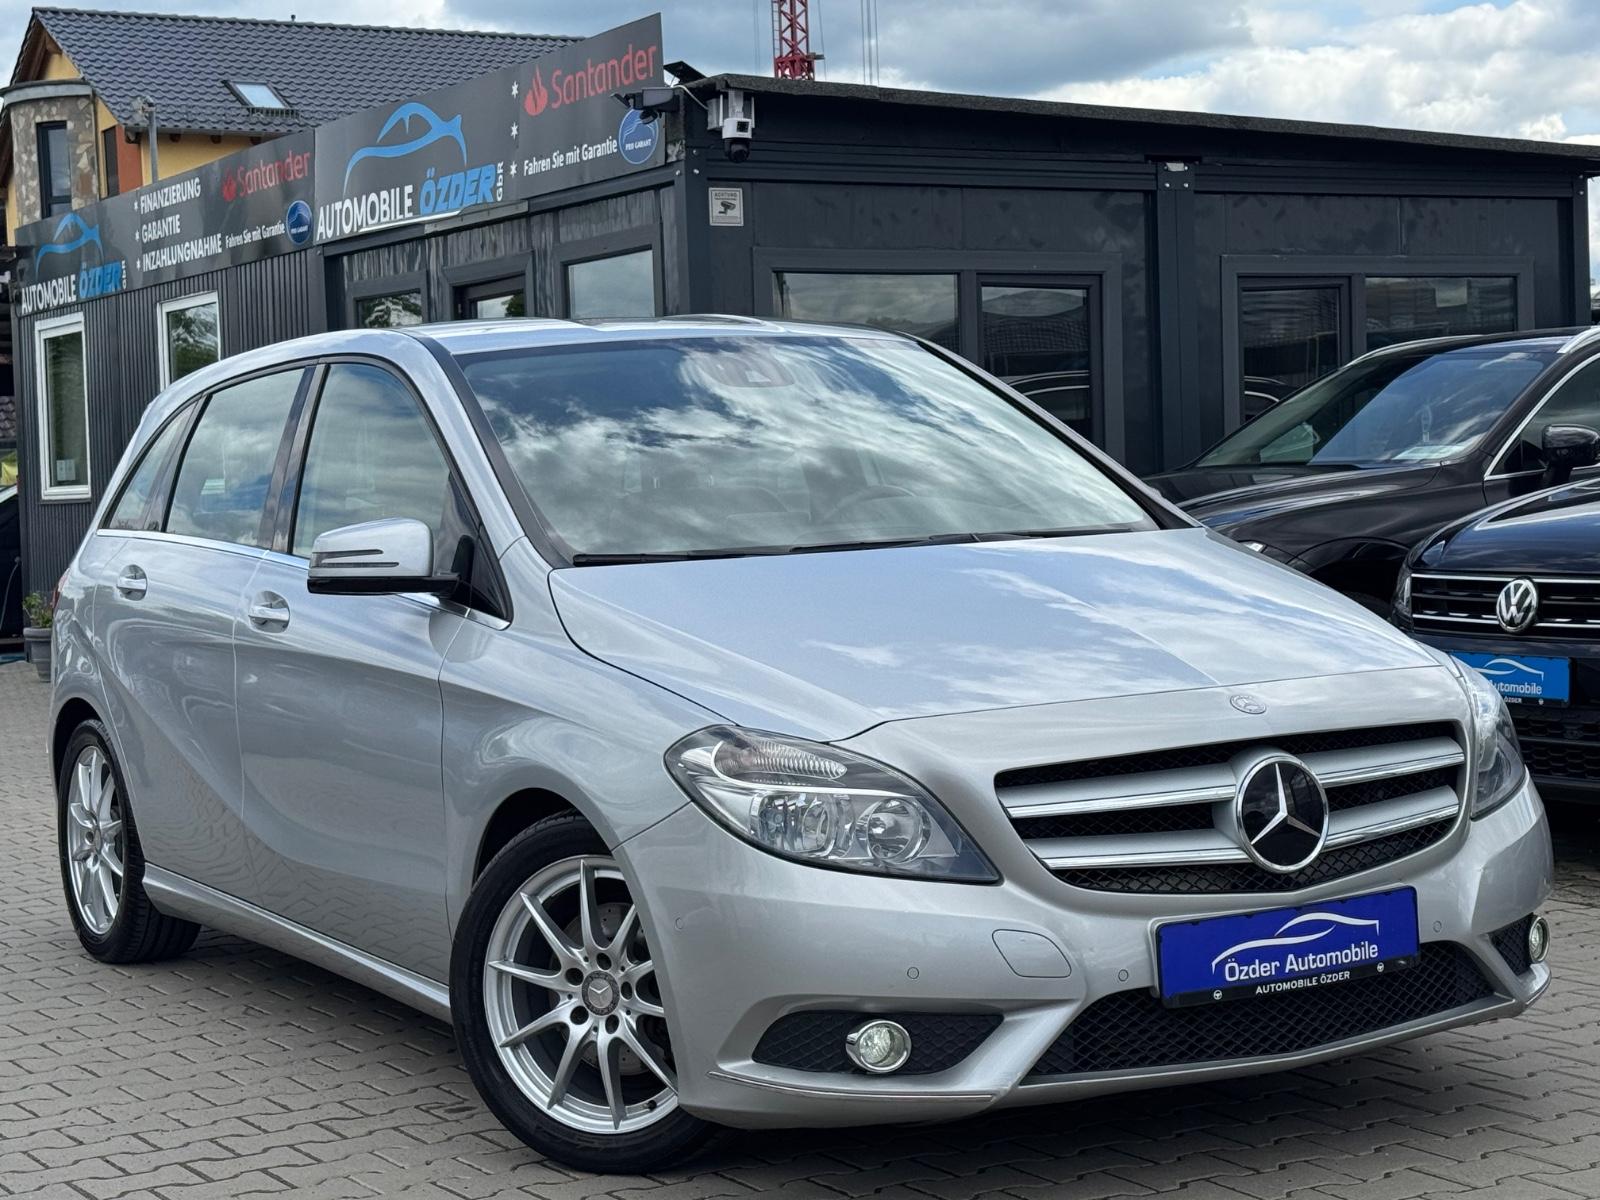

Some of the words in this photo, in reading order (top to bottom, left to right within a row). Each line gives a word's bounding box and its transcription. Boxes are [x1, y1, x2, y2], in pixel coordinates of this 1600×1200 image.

[551, 44, 656, 109] Santander
[237, 150, 310, 197] Santander
[523, 157, 551, 176] Fahren
[552, 150, 564, 169] Sie
[565, 145, 580, 165] mit
[581, 136, 618, 160] Garantie
[140, 177, 201, 214] FINANZIERUNG
[316, 184, 413, 241] AUTOMOBILE
[419, 164, 496, 216] ÖZDER
[496, 161, 504, 201] GbR
[141, 214, 181, 243] GARANTIE
[225, 233, 243, 248] Fahren
[243, 229, 251, 244] Sie
[252, 226, 262, 241] mit
[262, 220, 285, 239] Garantie
[142, 233, 222, 272] INZAHLUNGNAHME
[21, 274, 77, 315] AUTOMOBILE
[79, 261, 121, 298] ÖZDER
[1225, 957, 1280, 982] Özder
[1285, 941, 1378, 973] Automobile
[1255, 979, 1318, 995] AUTOMOBILE
[1320, 970, 1350, 985] ÖZDER
